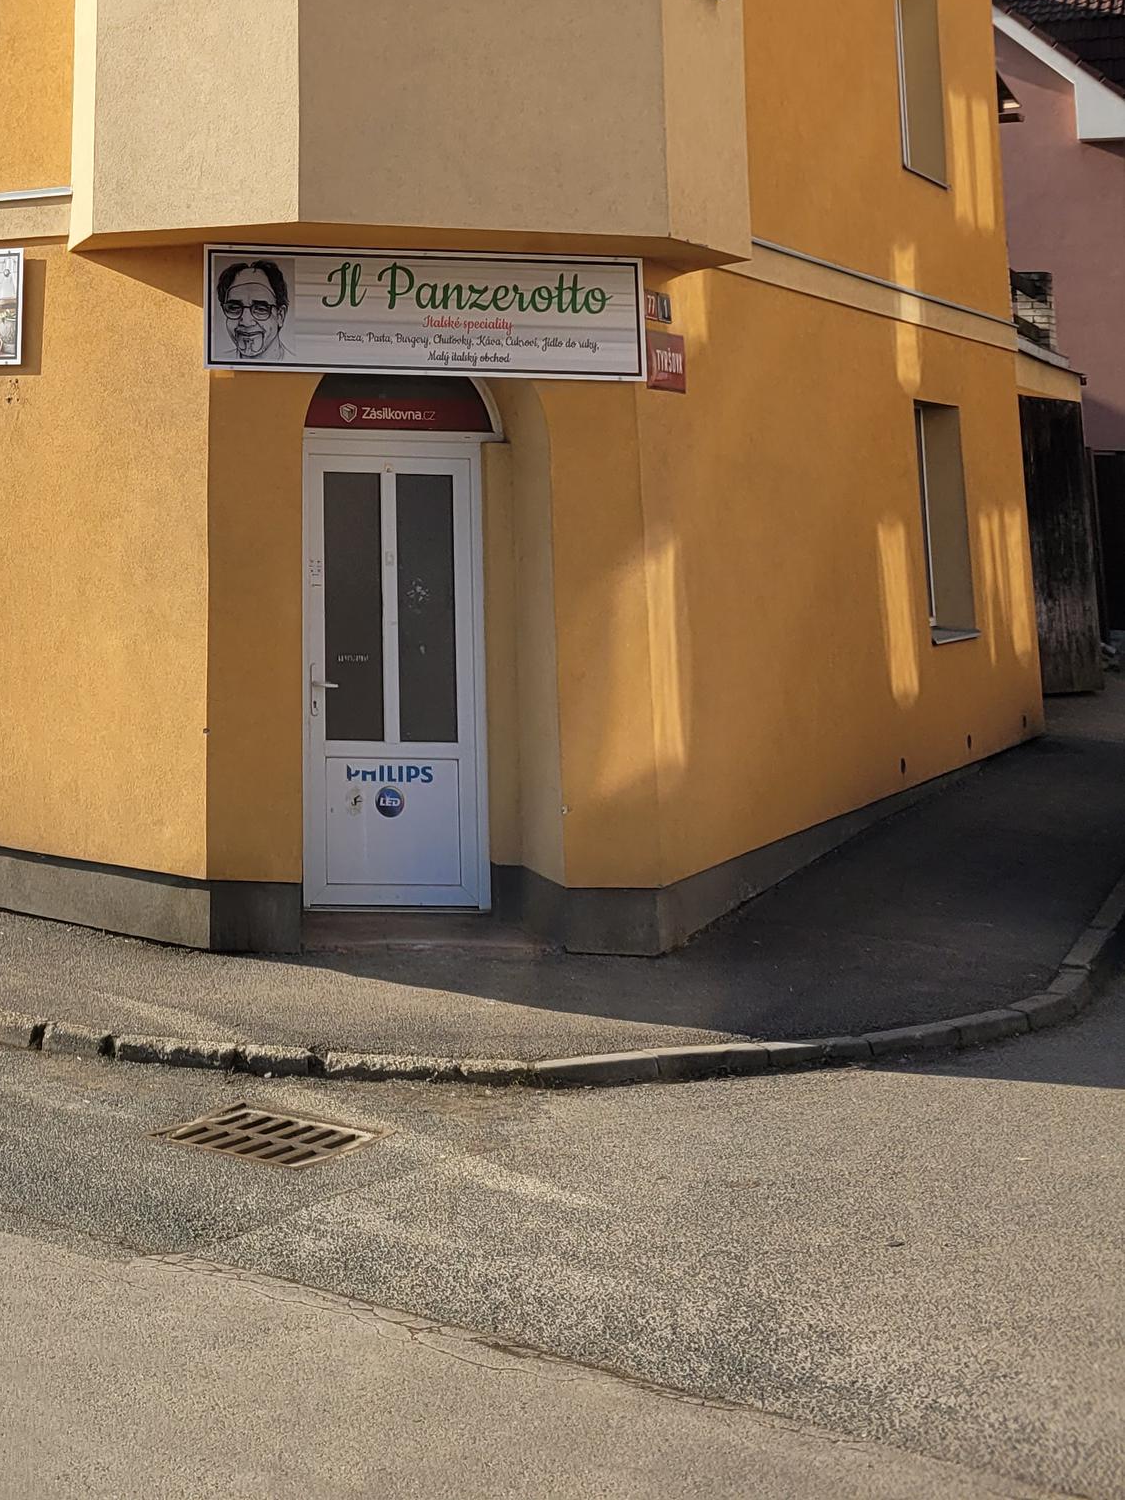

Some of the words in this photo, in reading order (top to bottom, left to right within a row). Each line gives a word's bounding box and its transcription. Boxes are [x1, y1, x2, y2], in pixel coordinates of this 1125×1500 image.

[322, 262, 366, 308] Il
[377, 262, 612, 314] Panzerotto
[422, 315, 462, 329] Italské
[463, 318, 514, 335] speciality
[336, 331, 364, 343] Pizza,
[366, 331, 393, 344] Pasta,
[476, 335, 503, 347] Káva,
[565, 337, 576, 348] do
[427, 351, 450, 365] Malý
[451, 352, 477, 366] italský
[479, 353, 511, 363] obchod
[362, 406, 436, 421] Zásilkovna.cz
[379, 797, 400, 806] LED
